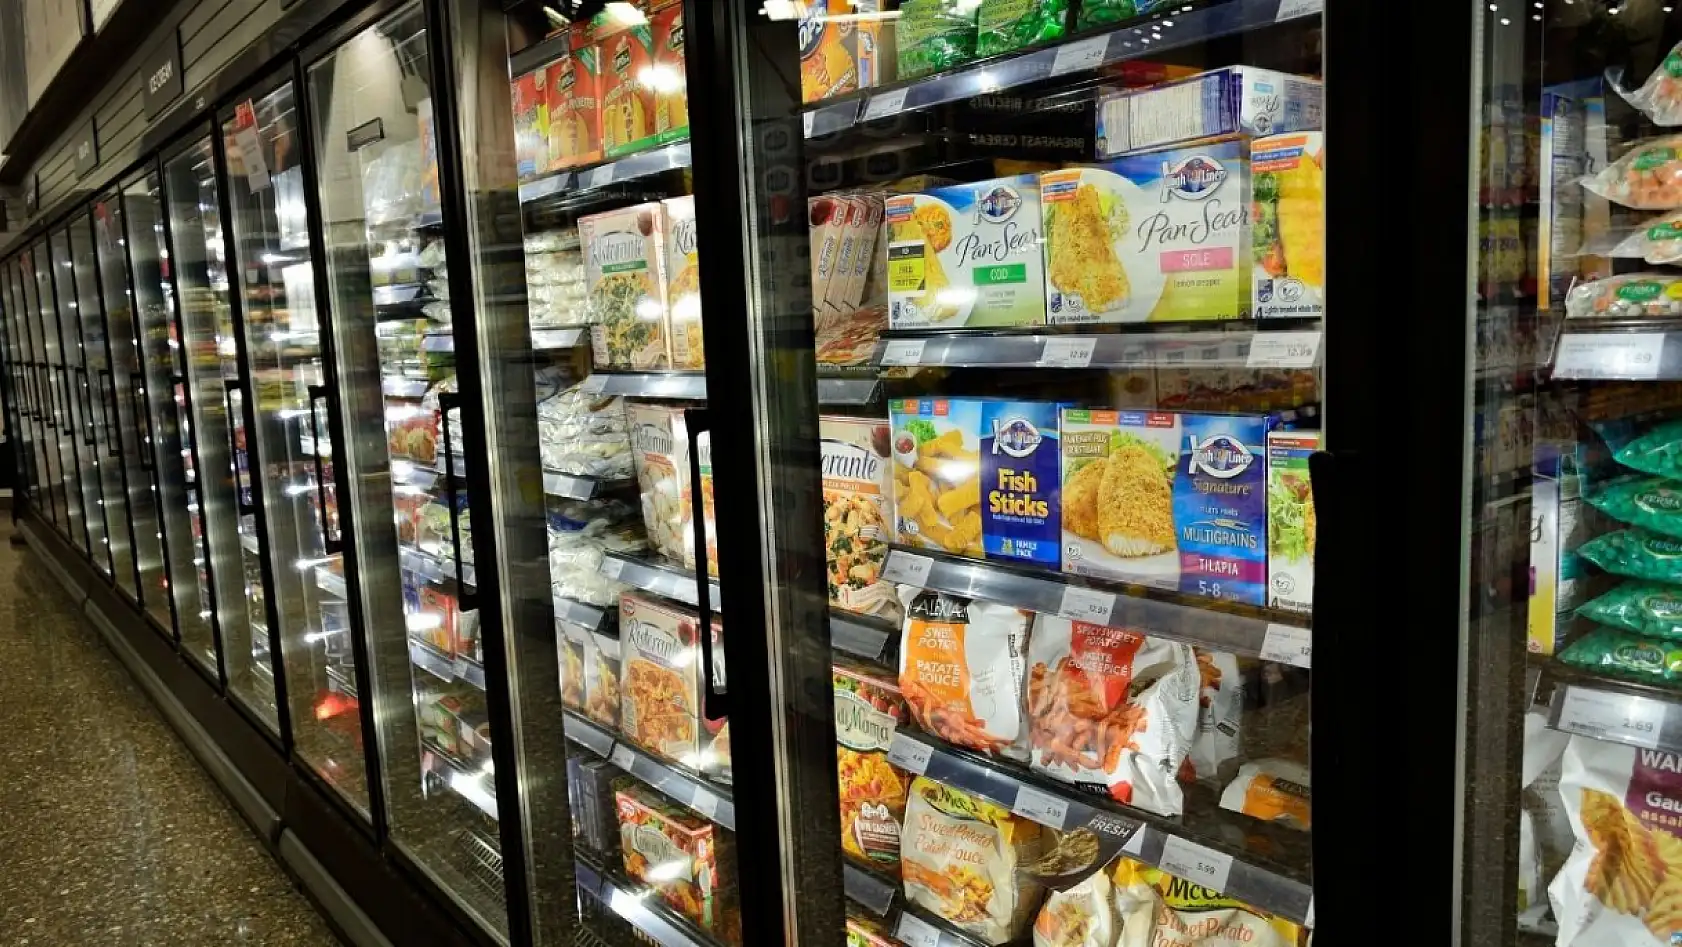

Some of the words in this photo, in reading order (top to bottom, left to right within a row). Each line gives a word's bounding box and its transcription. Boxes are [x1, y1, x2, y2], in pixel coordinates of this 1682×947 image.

[1138, 198, 1249, 254] Pan-Sear
[956, 221, 1038, 269] Pan-Sear
[1182, 253, 1211, 267] SOLE
[990, 268, 1009, 281] COD
[997, 467, 1038, 493] Fish
[1192, 477, 1250, 497] Signature
[988, 490, 1049, 519] Sticks
[1183, 526, 1258, 549] MULTIGRAINS
[1199, 558, 1239, 576] TILAPIA
[1198, 580, 1222, 598] 5-8
[916, 659, 962, 676] PATATE
[918, 670, 961, 688] DOUCE
[1622, 718, 1654, 733] 2.69
[1088, 818, 1131, 838] FRESH
